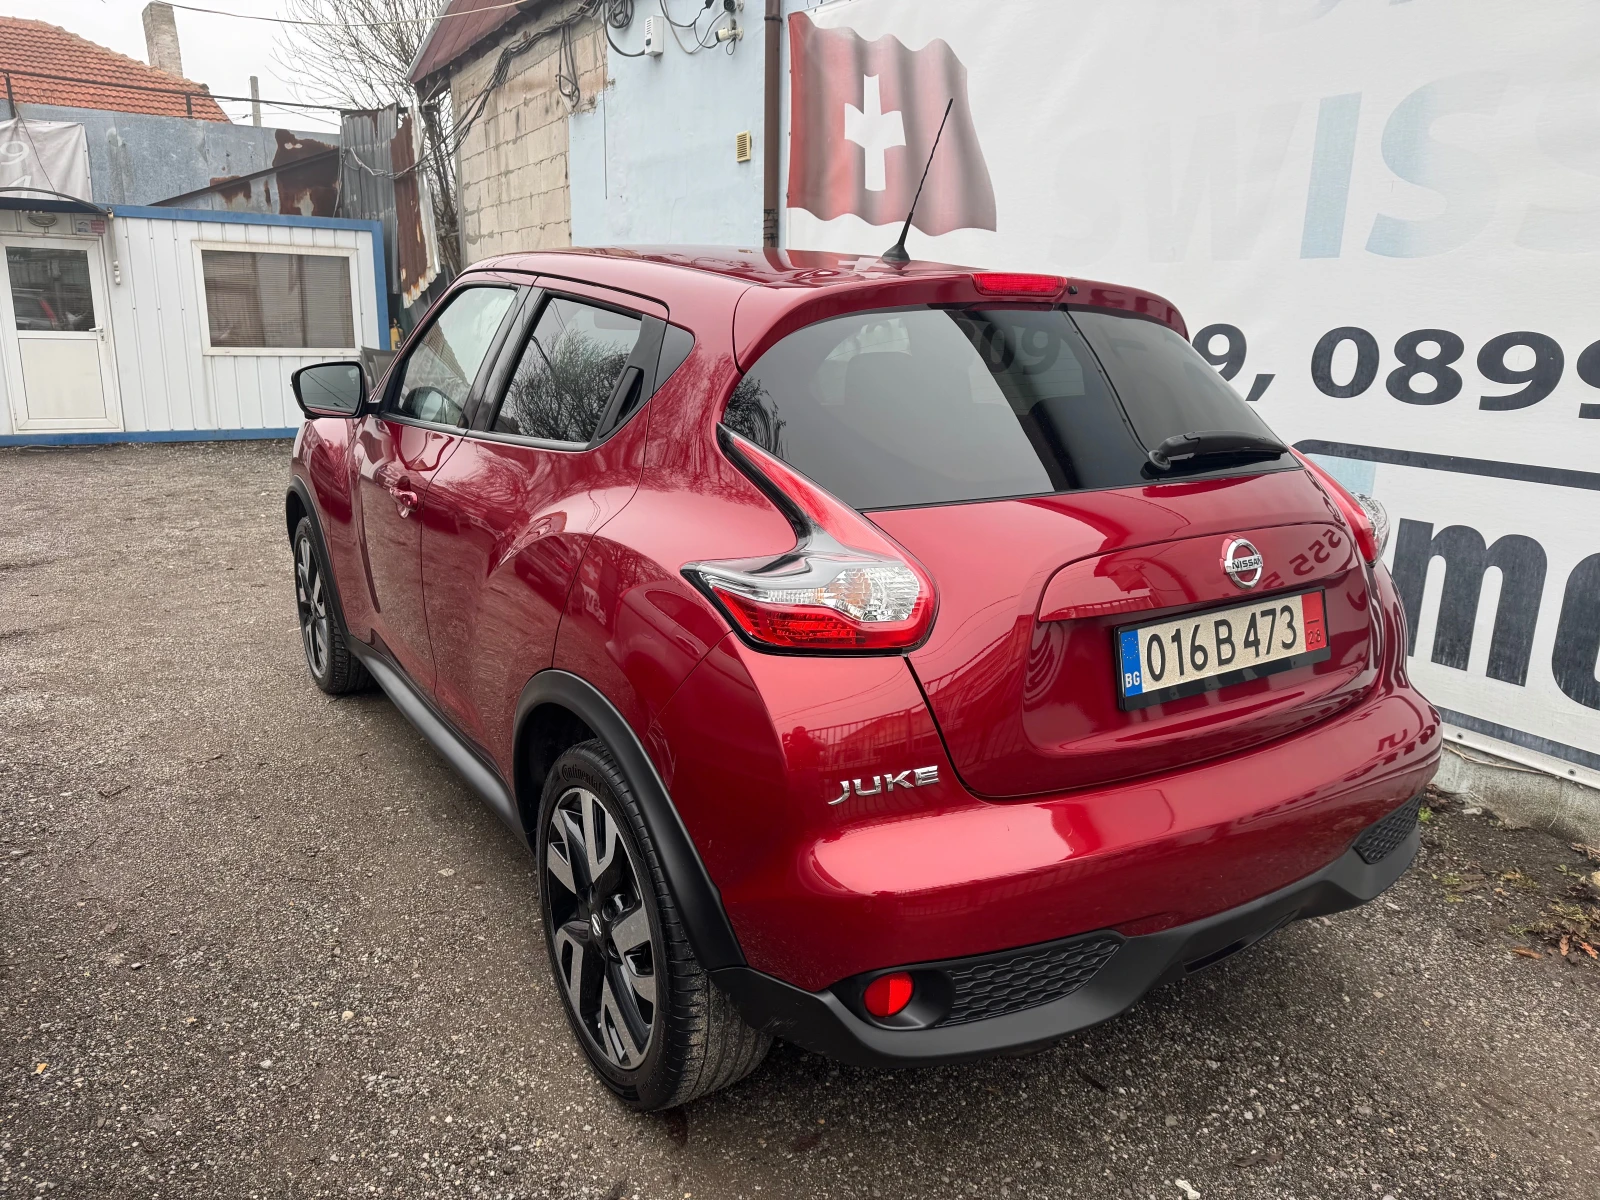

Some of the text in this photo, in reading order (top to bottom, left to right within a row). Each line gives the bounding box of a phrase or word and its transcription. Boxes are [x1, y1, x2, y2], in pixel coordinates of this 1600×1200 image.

[1310, 326, 1600, 419] 089
[1231, 555, 1263, 570] NISSAN
[1308, 629, 1322, 645] 28
[1124, 671, 1141, 688] BG
[827, 765, 940, 806] JUKE
